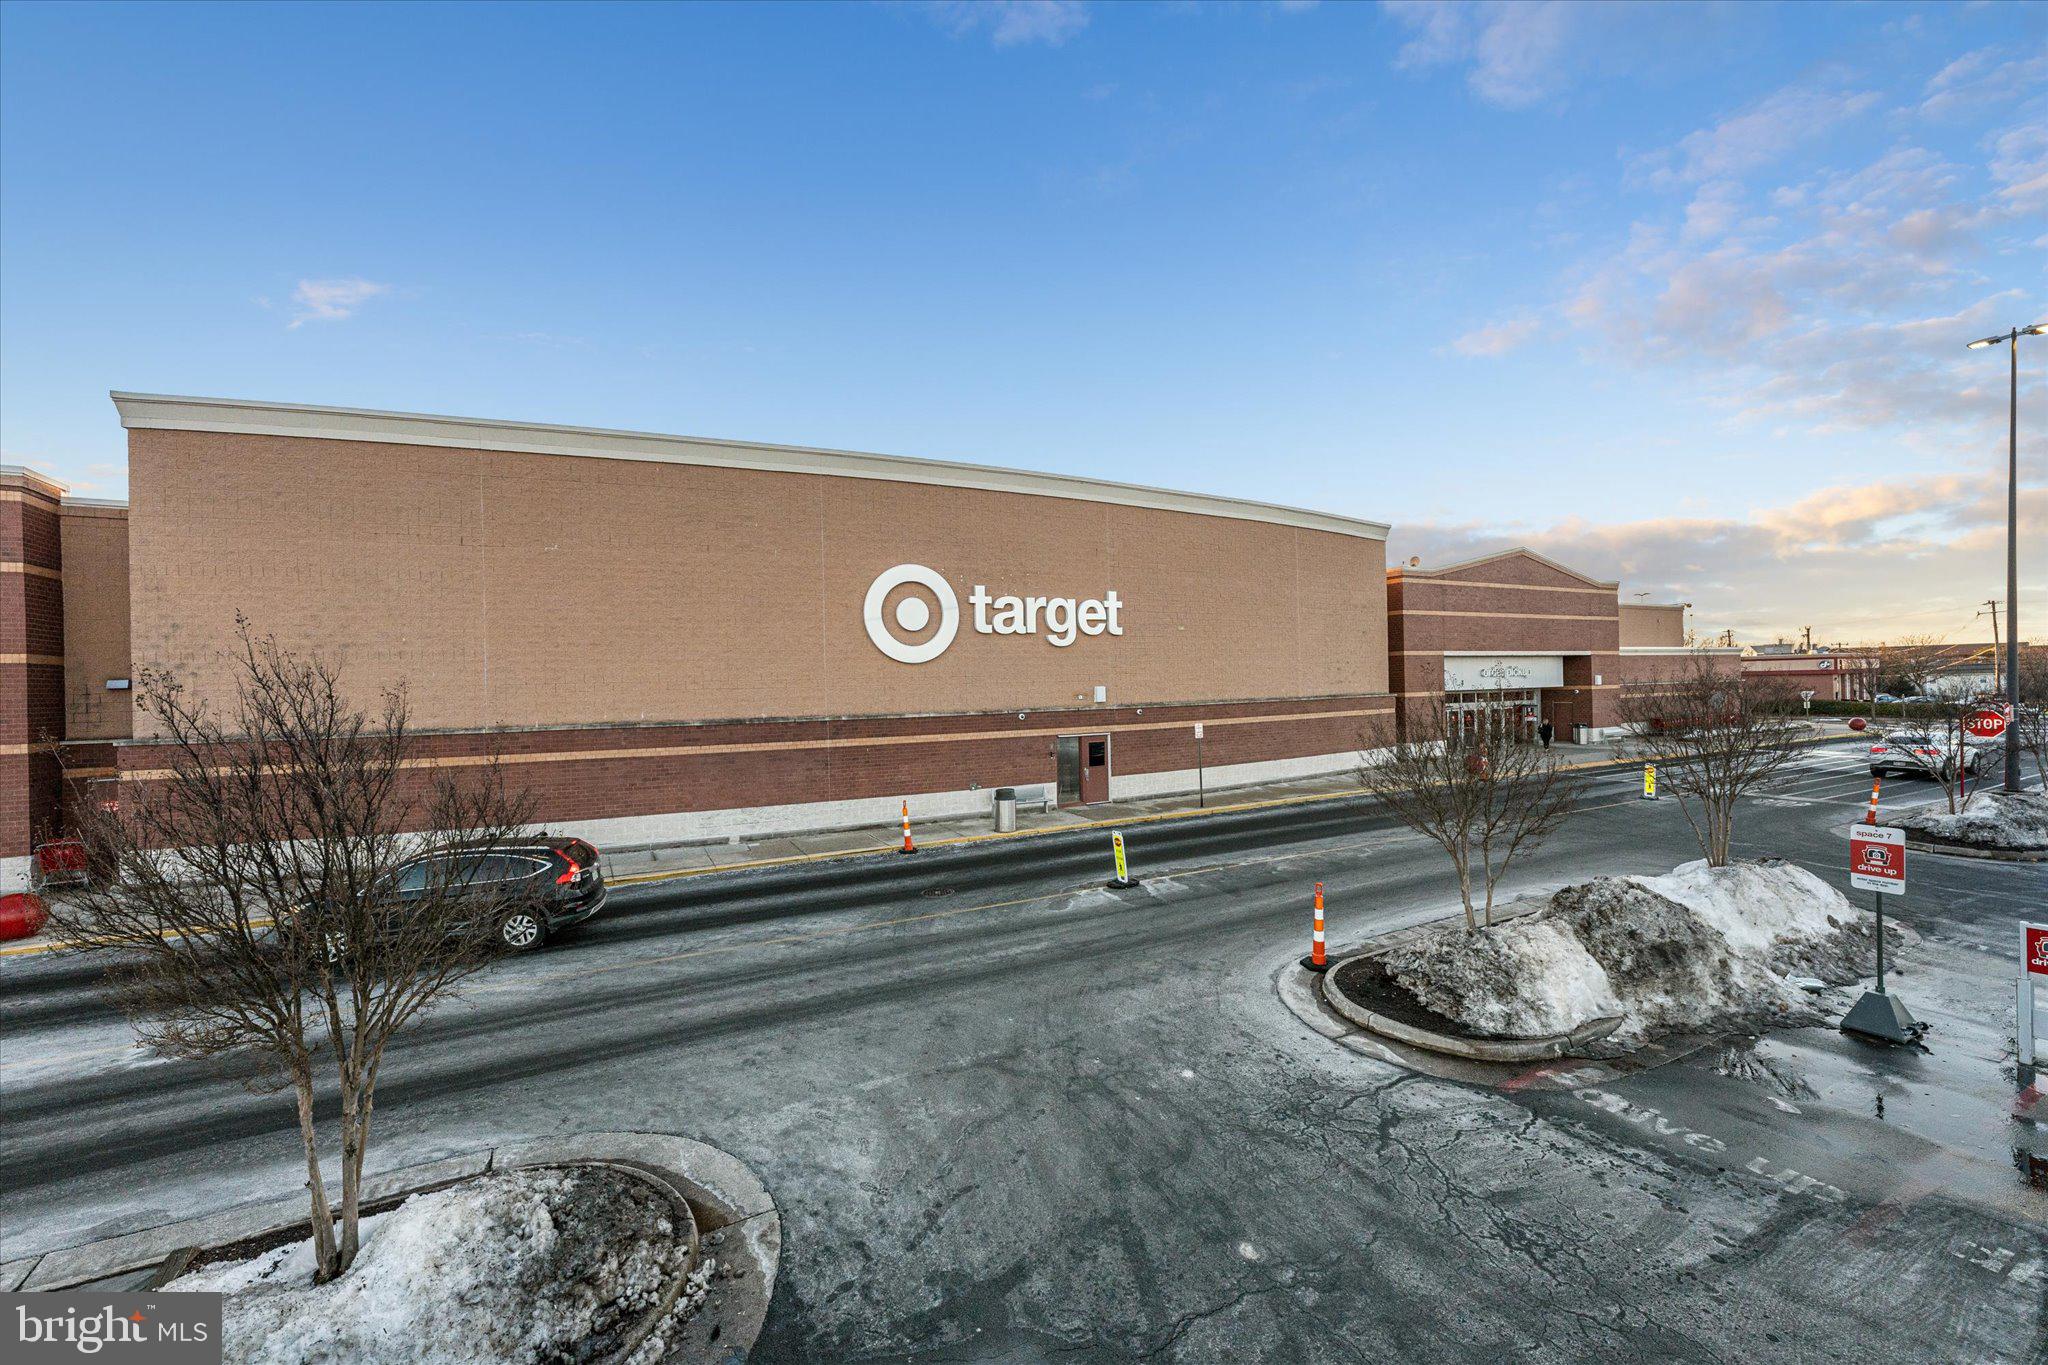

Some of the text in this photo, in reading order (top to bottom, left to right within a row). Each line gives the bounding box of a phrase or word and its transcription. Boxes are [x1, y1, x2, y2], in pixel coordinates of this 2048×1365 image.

[969, 585, 1124, 647] target
[1966, 718, 2003, 730] STOP
[1857, 864, 1897, 876] drive up
[2031, 958, 2048, 967] dri
